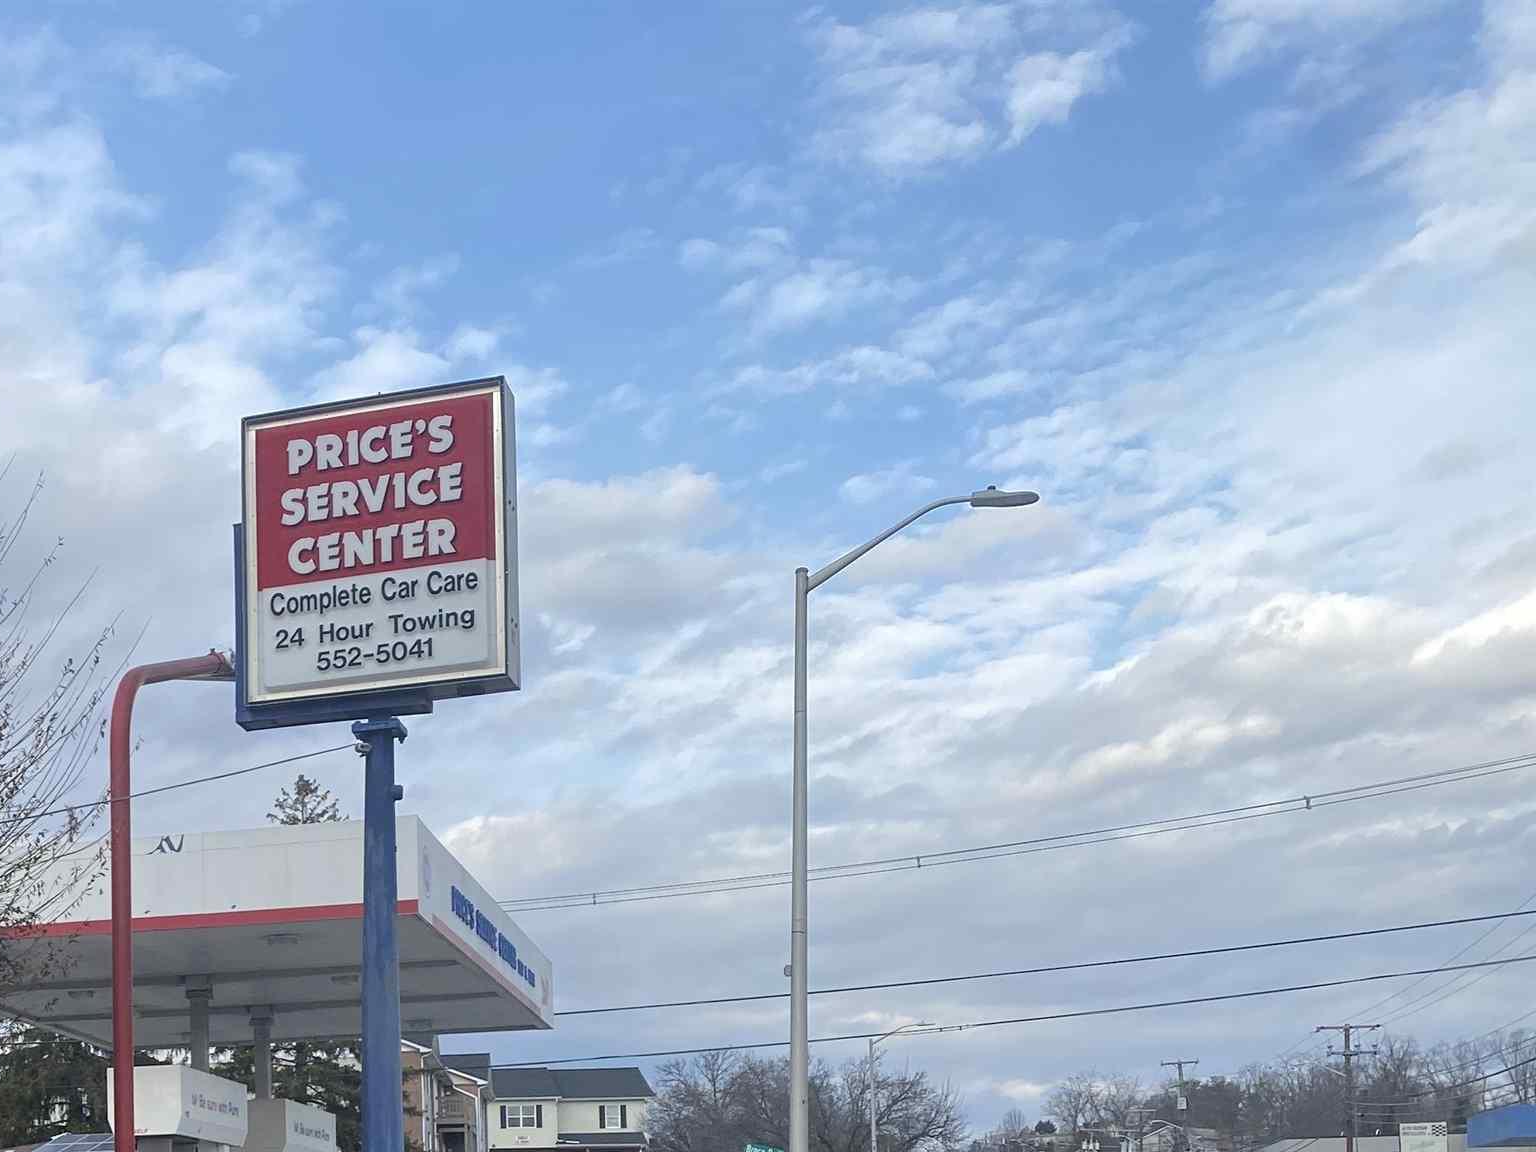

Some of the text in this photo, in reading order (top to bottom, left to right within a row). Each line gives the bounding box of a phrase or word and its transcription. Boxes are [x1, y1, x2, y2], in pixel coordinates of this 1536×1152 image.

[287, 415, 455, 475] PRICE'S
[280, 462, 462, 526] SERVICE
[287, 518, 457, 575] CENTER
[270, 569, 479, 617] Complete Car Care
[275, 607, 476, 650] 24 Hour Towing
[316, 637, 435, 672] 552-5041
